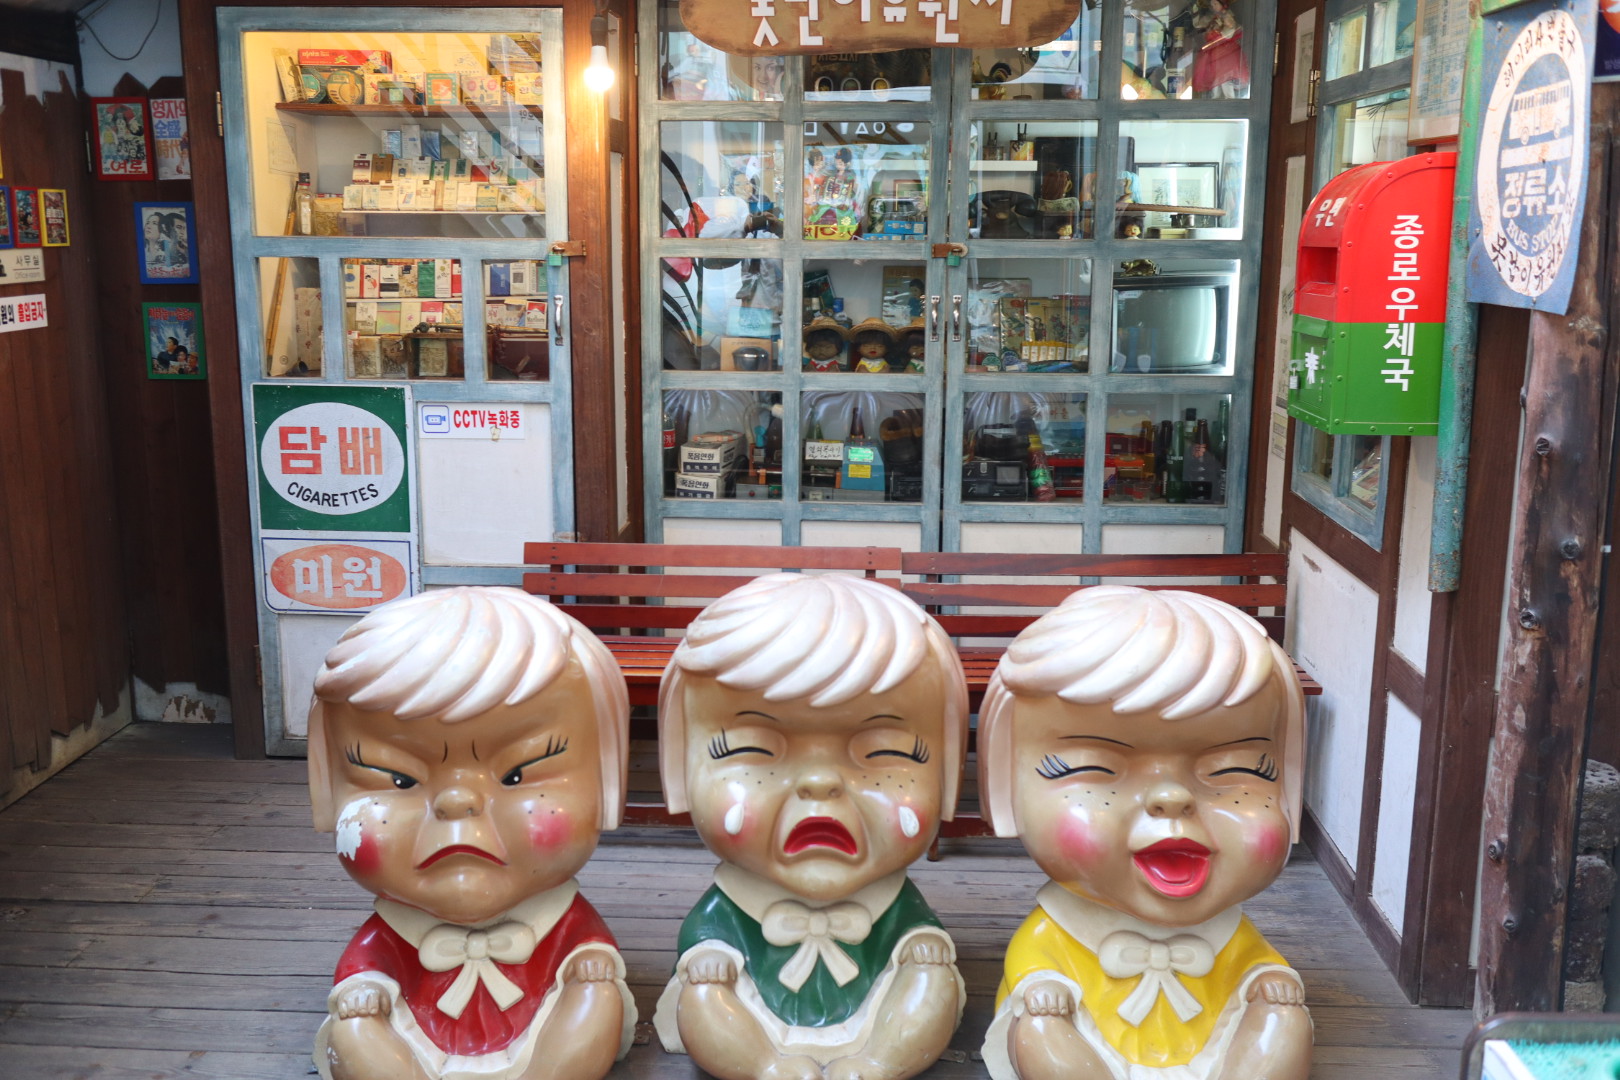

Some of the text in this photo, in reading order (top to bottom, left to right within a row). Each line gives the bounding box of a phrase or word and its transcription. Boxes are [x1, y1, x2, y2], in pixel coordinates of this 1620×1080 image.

[1502, 165, 1567, 218] 정류소
[1314, 197, 1348, 227] 우편
[1506, 214, 1559, 254] BUS STOP
[16, 254, 39, 266] 사무실
[0, 301, 44, 325] 원외 출입금지
[1380, 215, 1424, 391] 종로우체국
[279, 426, 383, 475] 담배
[287, 481, 379, 507] CIGARETTES
[292, 553, 383, 599] 미원
